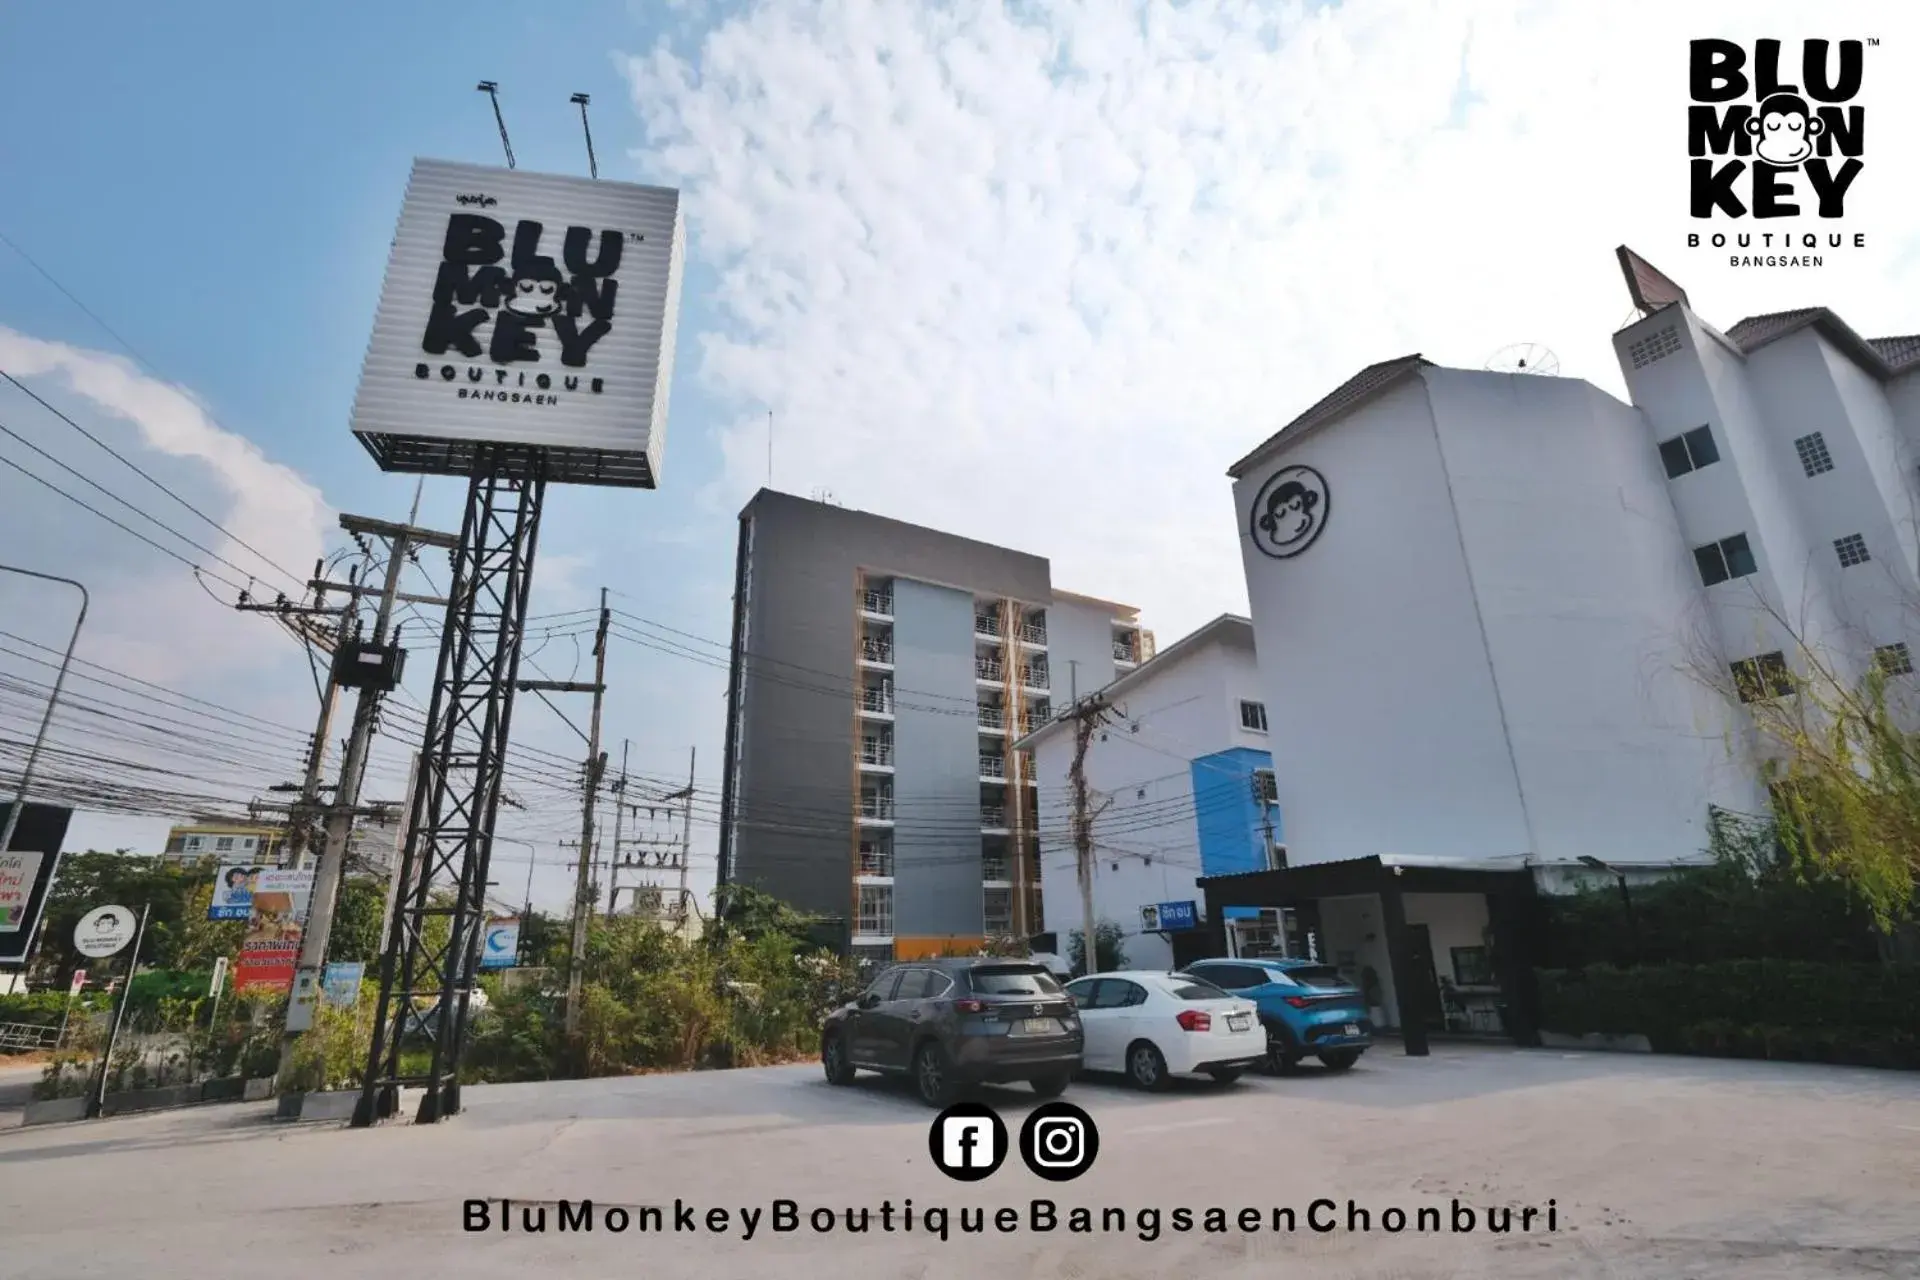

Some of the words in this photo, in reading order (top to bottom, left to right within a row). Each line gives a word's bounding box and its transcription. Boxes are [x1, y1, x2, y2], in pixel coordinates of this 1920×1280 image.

[443, 213, 625, 278] BLU
[432, 261, 619, 320] MN
[422, 303, 613, 368] KEY
[414, 362, 605, 394] BOUTIQUE
[457, 387, 558, 406] BANGSAEN
